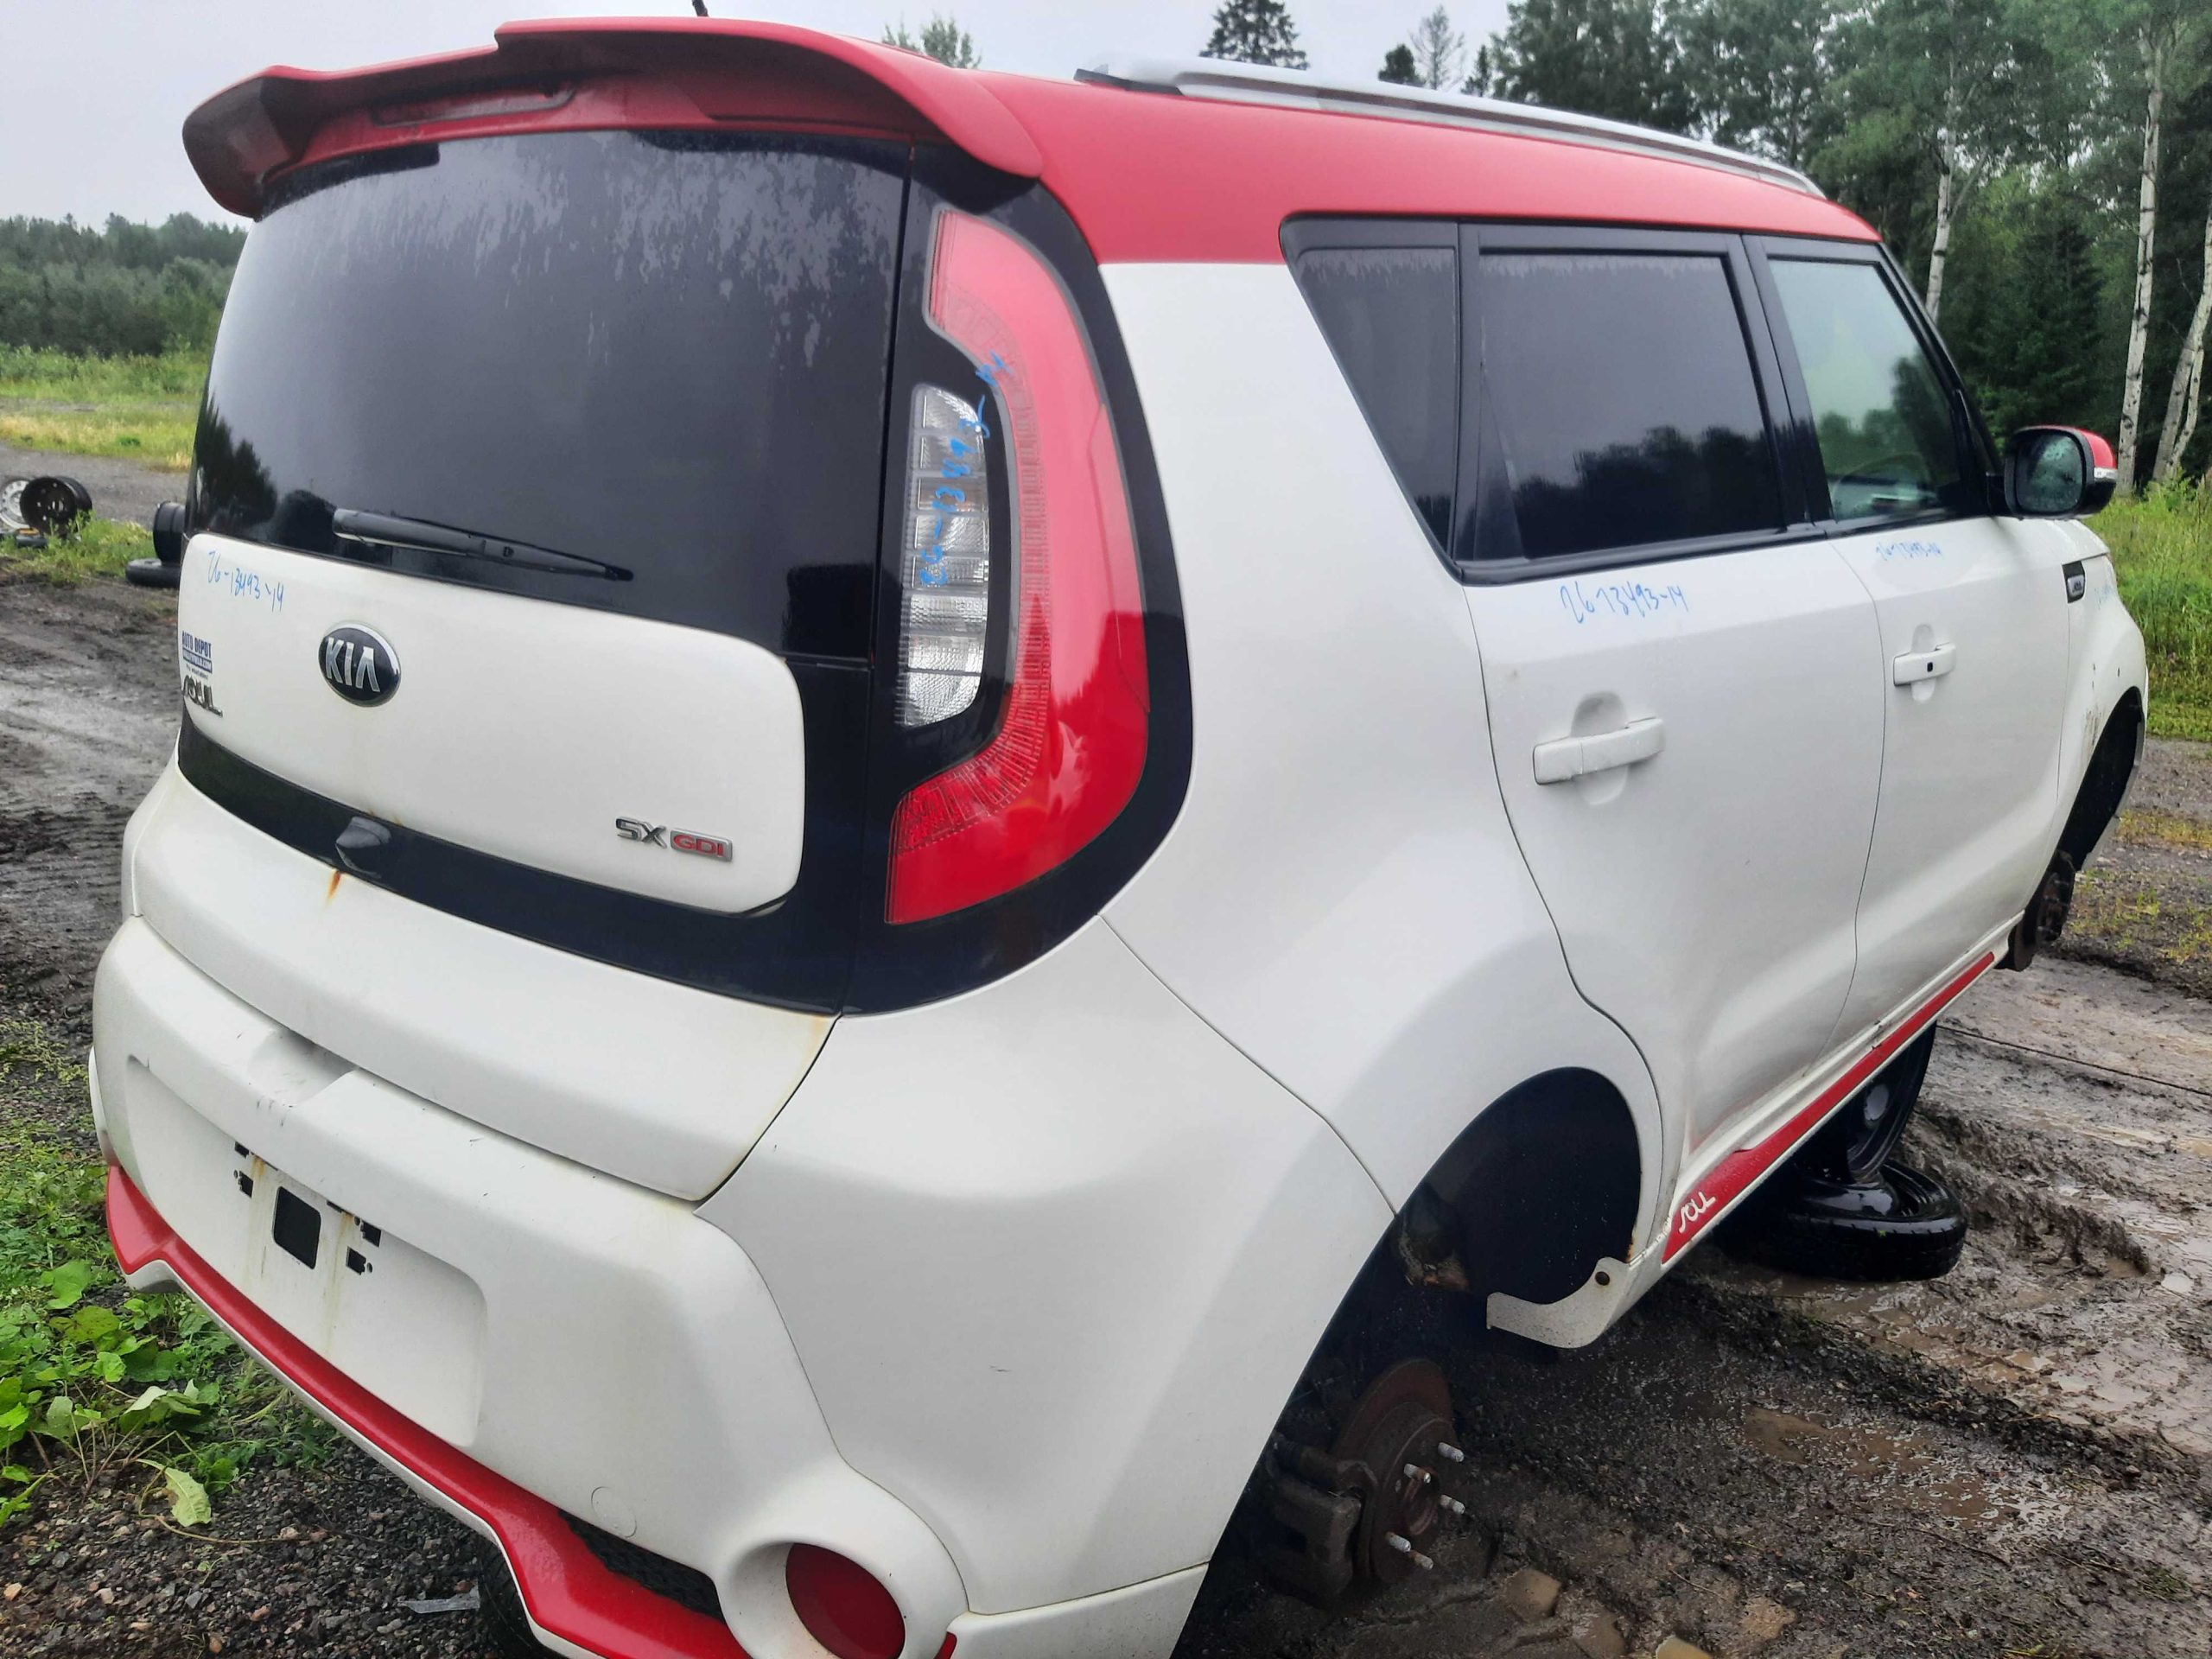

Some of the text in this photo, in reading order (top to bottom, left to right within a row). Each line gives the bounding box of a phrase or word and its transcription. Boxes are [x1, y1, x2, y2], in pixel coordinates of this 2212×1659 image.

[325, 636, 381, 693] KIA
[615, 817, 725, 858] SX GDI
